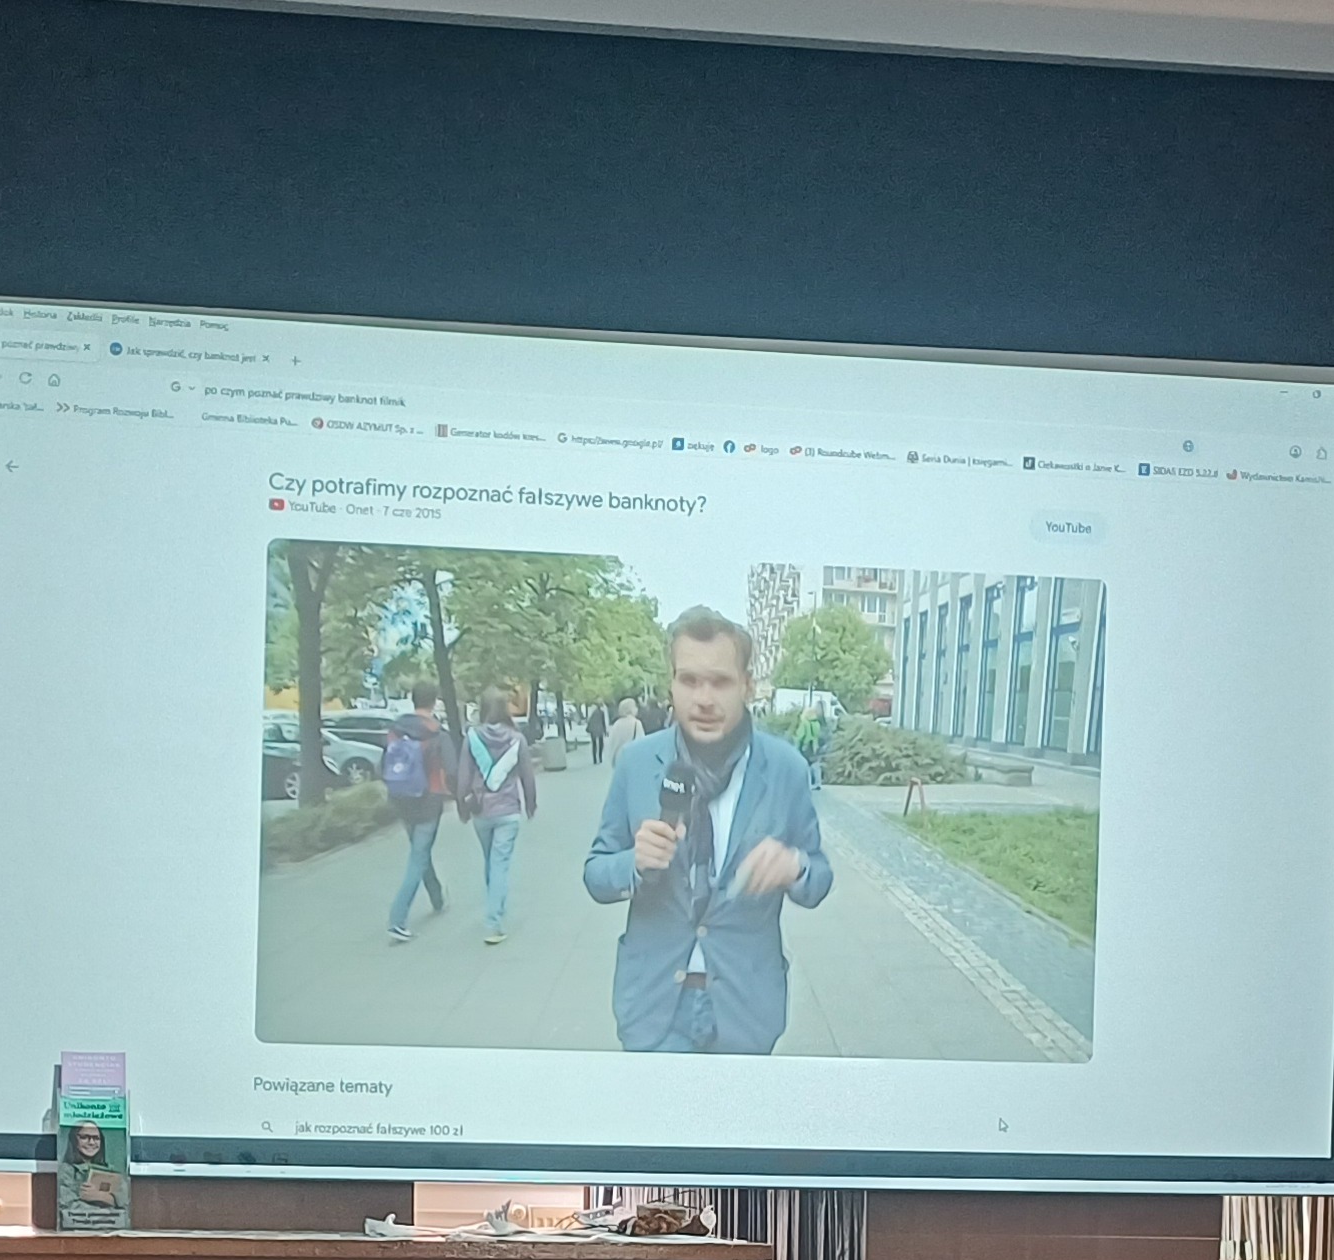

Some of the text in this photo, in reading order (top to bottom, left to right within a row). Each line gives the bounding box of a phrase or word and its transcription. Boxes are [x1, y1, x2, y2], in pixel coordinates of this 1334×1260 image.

[188, 351, 202, 361] czy
[204, 351, 239, 362] banknot
[205, 387, 217, 396] po
[221, 387, 245, 398] czym
[248, 387, 283, 400] poznać
[338, 393, 377, 405] banknot
[268, 472, 307, 496] Czy
[311, 476, 408, 501] potrafimy
[412, 484, 513, 505] rozpoznać
[608, 492, 708, 517] banknoty?
[289, 501, 336, 514] YouTube
[346, 503, 375, 516] Onet
[392, 508, 412, 518] cze
[415, 507, 441, 519] 2015
[1045, 520, 1092, 534] YouTube
[253, 1077, 393, 1098] Powiązane tematy
[294, 1121, 311, 1135] jak
[314, 1122, 373, 1135] rozpoznać
[430, 1124, 450, 1136] 100
